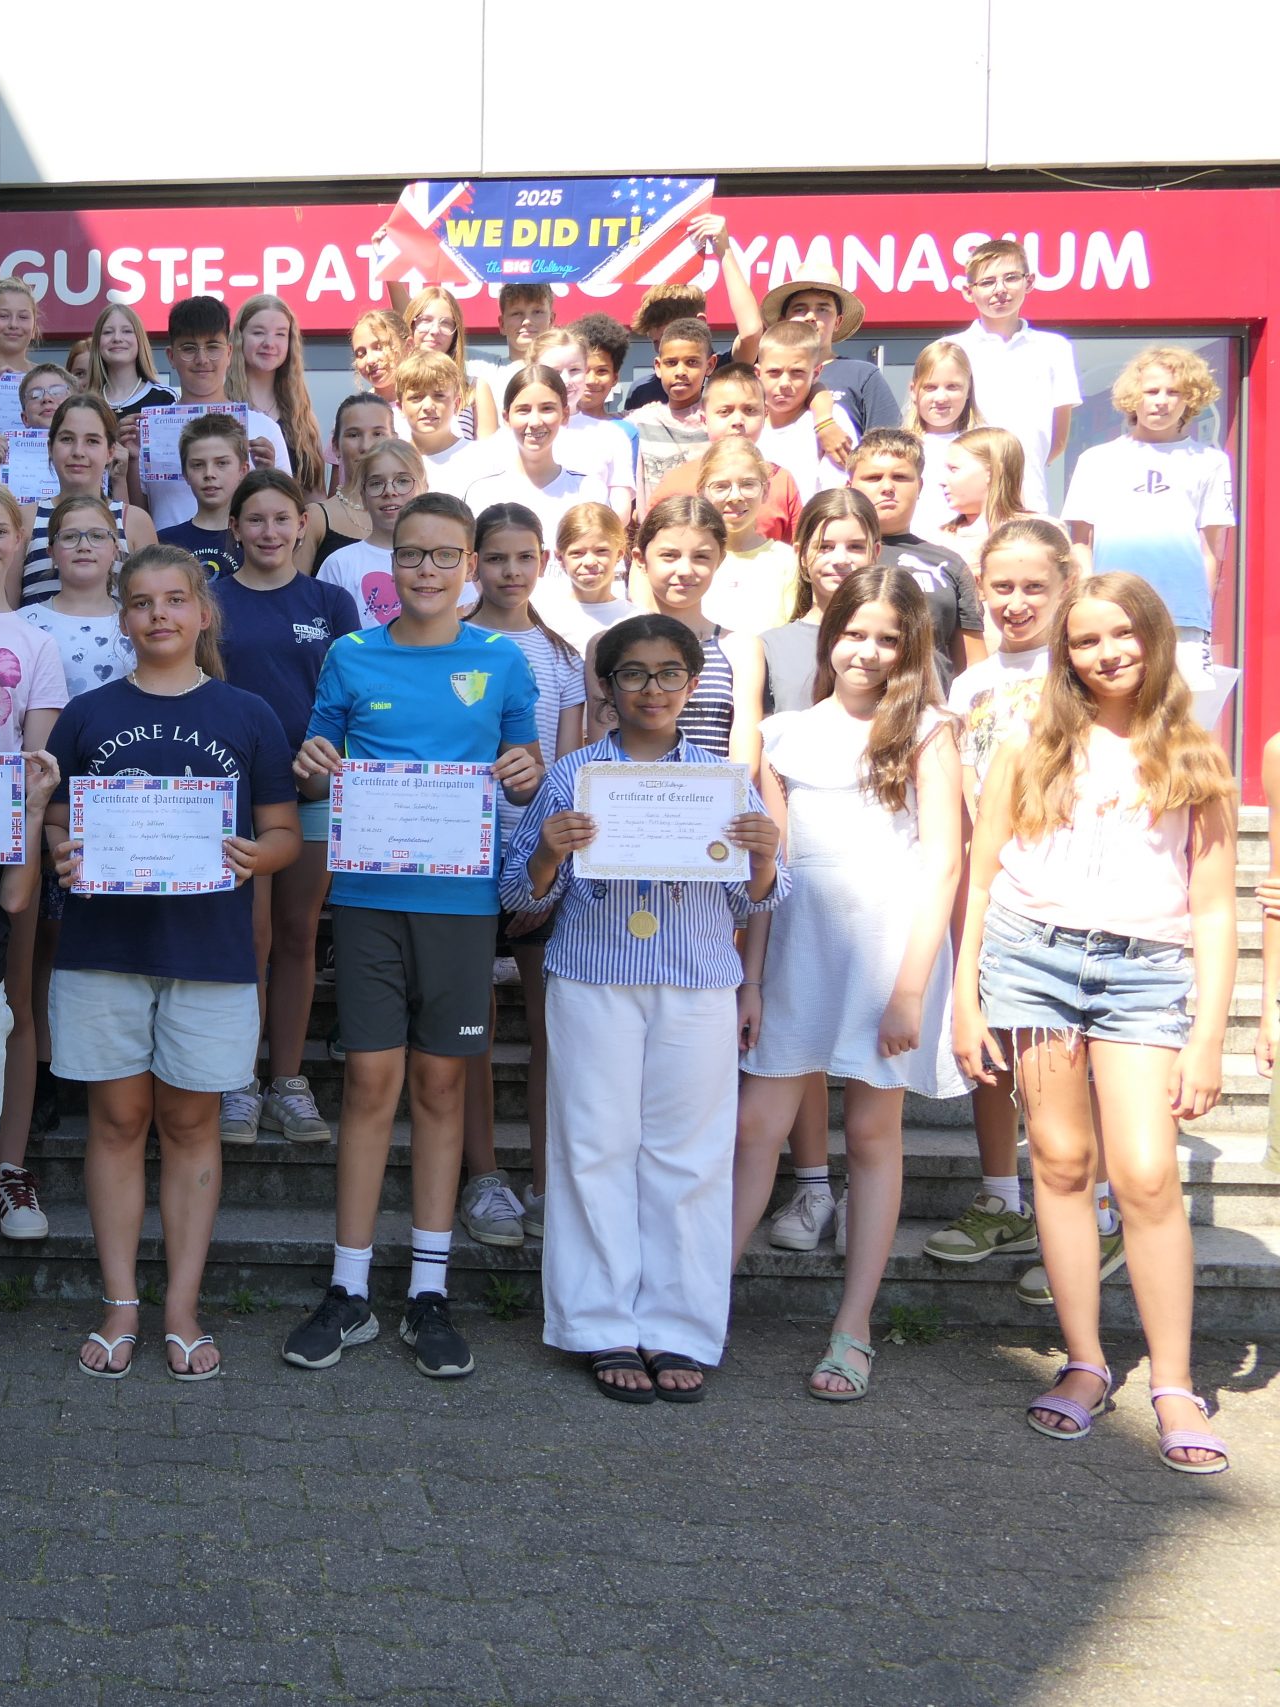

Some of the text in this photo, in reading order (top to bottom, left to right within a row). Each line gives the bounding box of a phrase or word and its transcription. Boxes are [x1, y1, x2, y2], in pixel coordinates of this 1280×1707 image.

[515, 189, 563, 207] 2025
[446, 216, 642, 248] WE DID IT!
[503, 259, 531, 273] BIG
[531, 259, 580, 278] Challenge
[173, 725, 200, 746] LA
[204, 740, 241, 780] MER
[352, 776, 475, 789] Certificate of Participation
[92, 794, 214, 806] Certificate of Participation
[608, 791, 714, 803] Certificate of Excellence
[388, 835, 433, 843] Congratulations!
[130, 853, 175, 862] Congratulations!
[459, 1025, 484, 1036] JAKO
